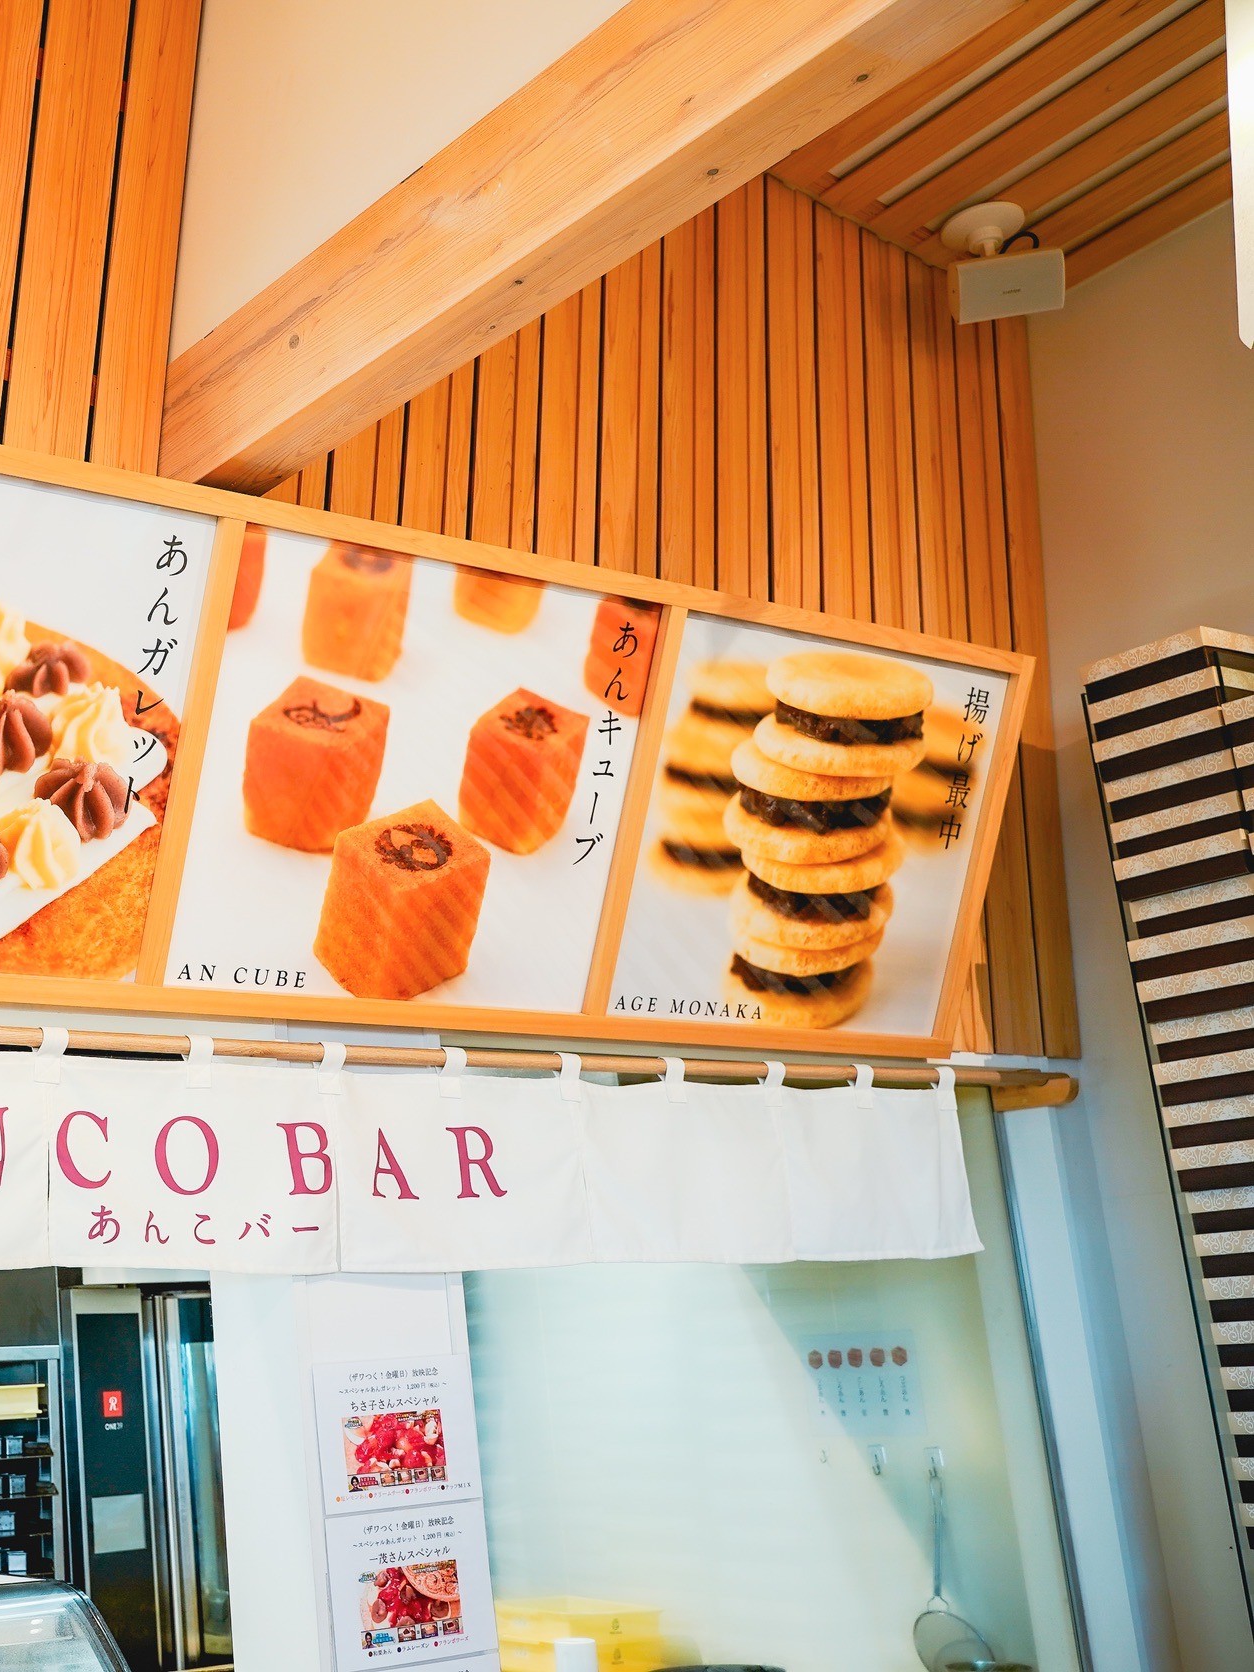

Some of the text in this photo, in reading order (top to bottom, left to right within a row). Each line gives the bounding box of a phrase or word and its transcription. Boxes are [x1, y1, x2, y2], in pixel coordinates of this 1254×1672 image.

[124, 534, 189, 815] あんガレット
[573, 621, 638, 865] あんキューブ
[938, 686, 990, 850] 揚げ最中
[178, 963, 308, 989] AN CUBE
[614, 996, 764, 1021] AGE MONAKA
[87, 1204, 320, 1246] あんこバー
[350, 1396, 439, 1412] ちさ子さんスペシャル
[369, 1546, 451, 1564] 一茂さんスペシャル
